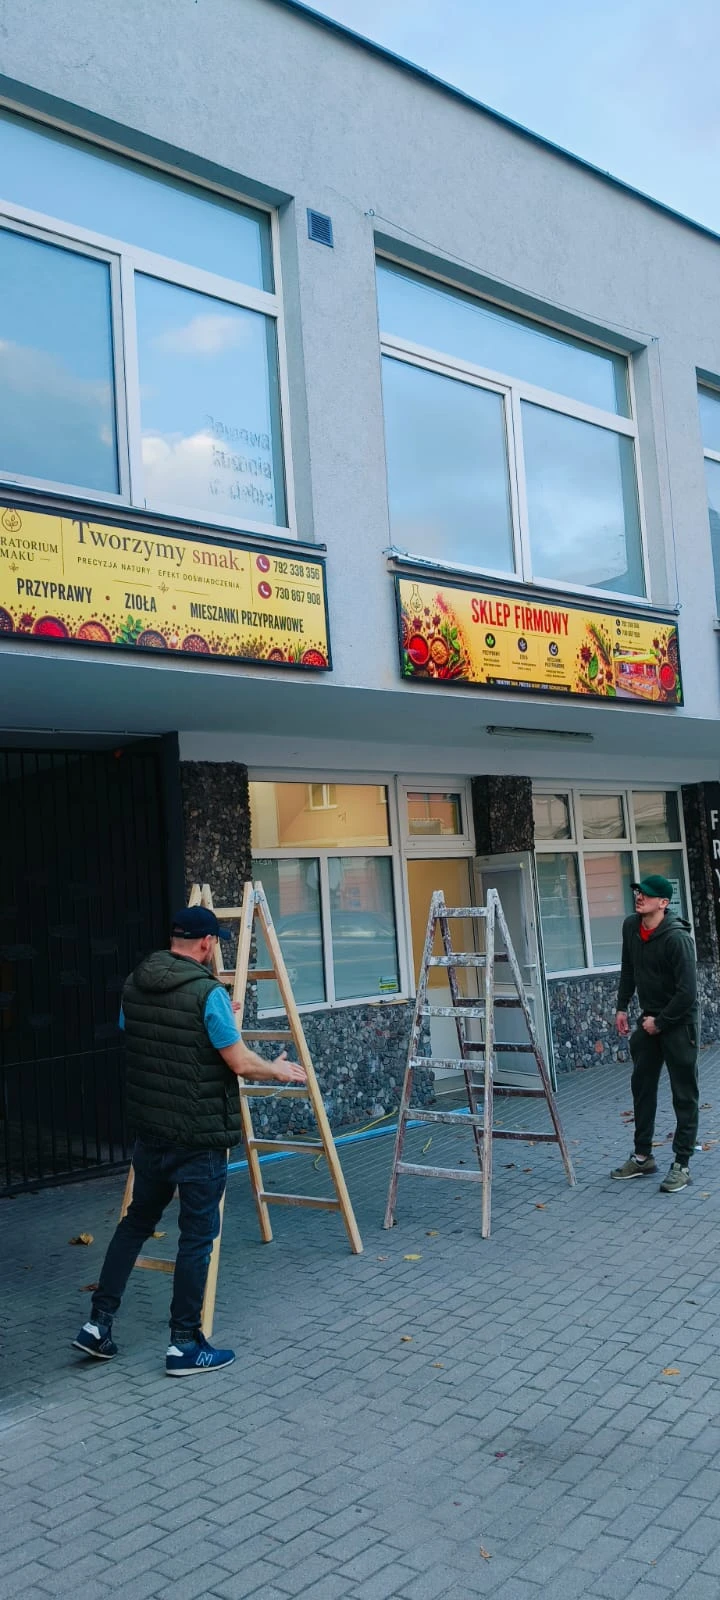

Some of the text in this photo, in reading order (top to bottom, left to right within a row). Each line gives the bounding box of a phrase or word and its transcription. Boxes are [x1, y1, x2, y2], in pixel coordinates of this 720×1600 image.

[0, 536, 58, 553] RATORIUM
[72, 520, 245, 572] Tworzymy smak.
[77, 556, 118, 569] PRECYZJA
[158, 569, 180, 579] EFEKT
[273, 560, 320, 580] 792 338 356
[16, 577, 305, 634] PRZYPRAWY ZIOŁA MIESZANKI PRZYPRAWOWE
[274, 586, 290, 600] 730
[306, 591, 321, 605] 908
[471, 598, 569, 636] SKLEP FIRMOWY
[196, 1351, 213, 1368] N
